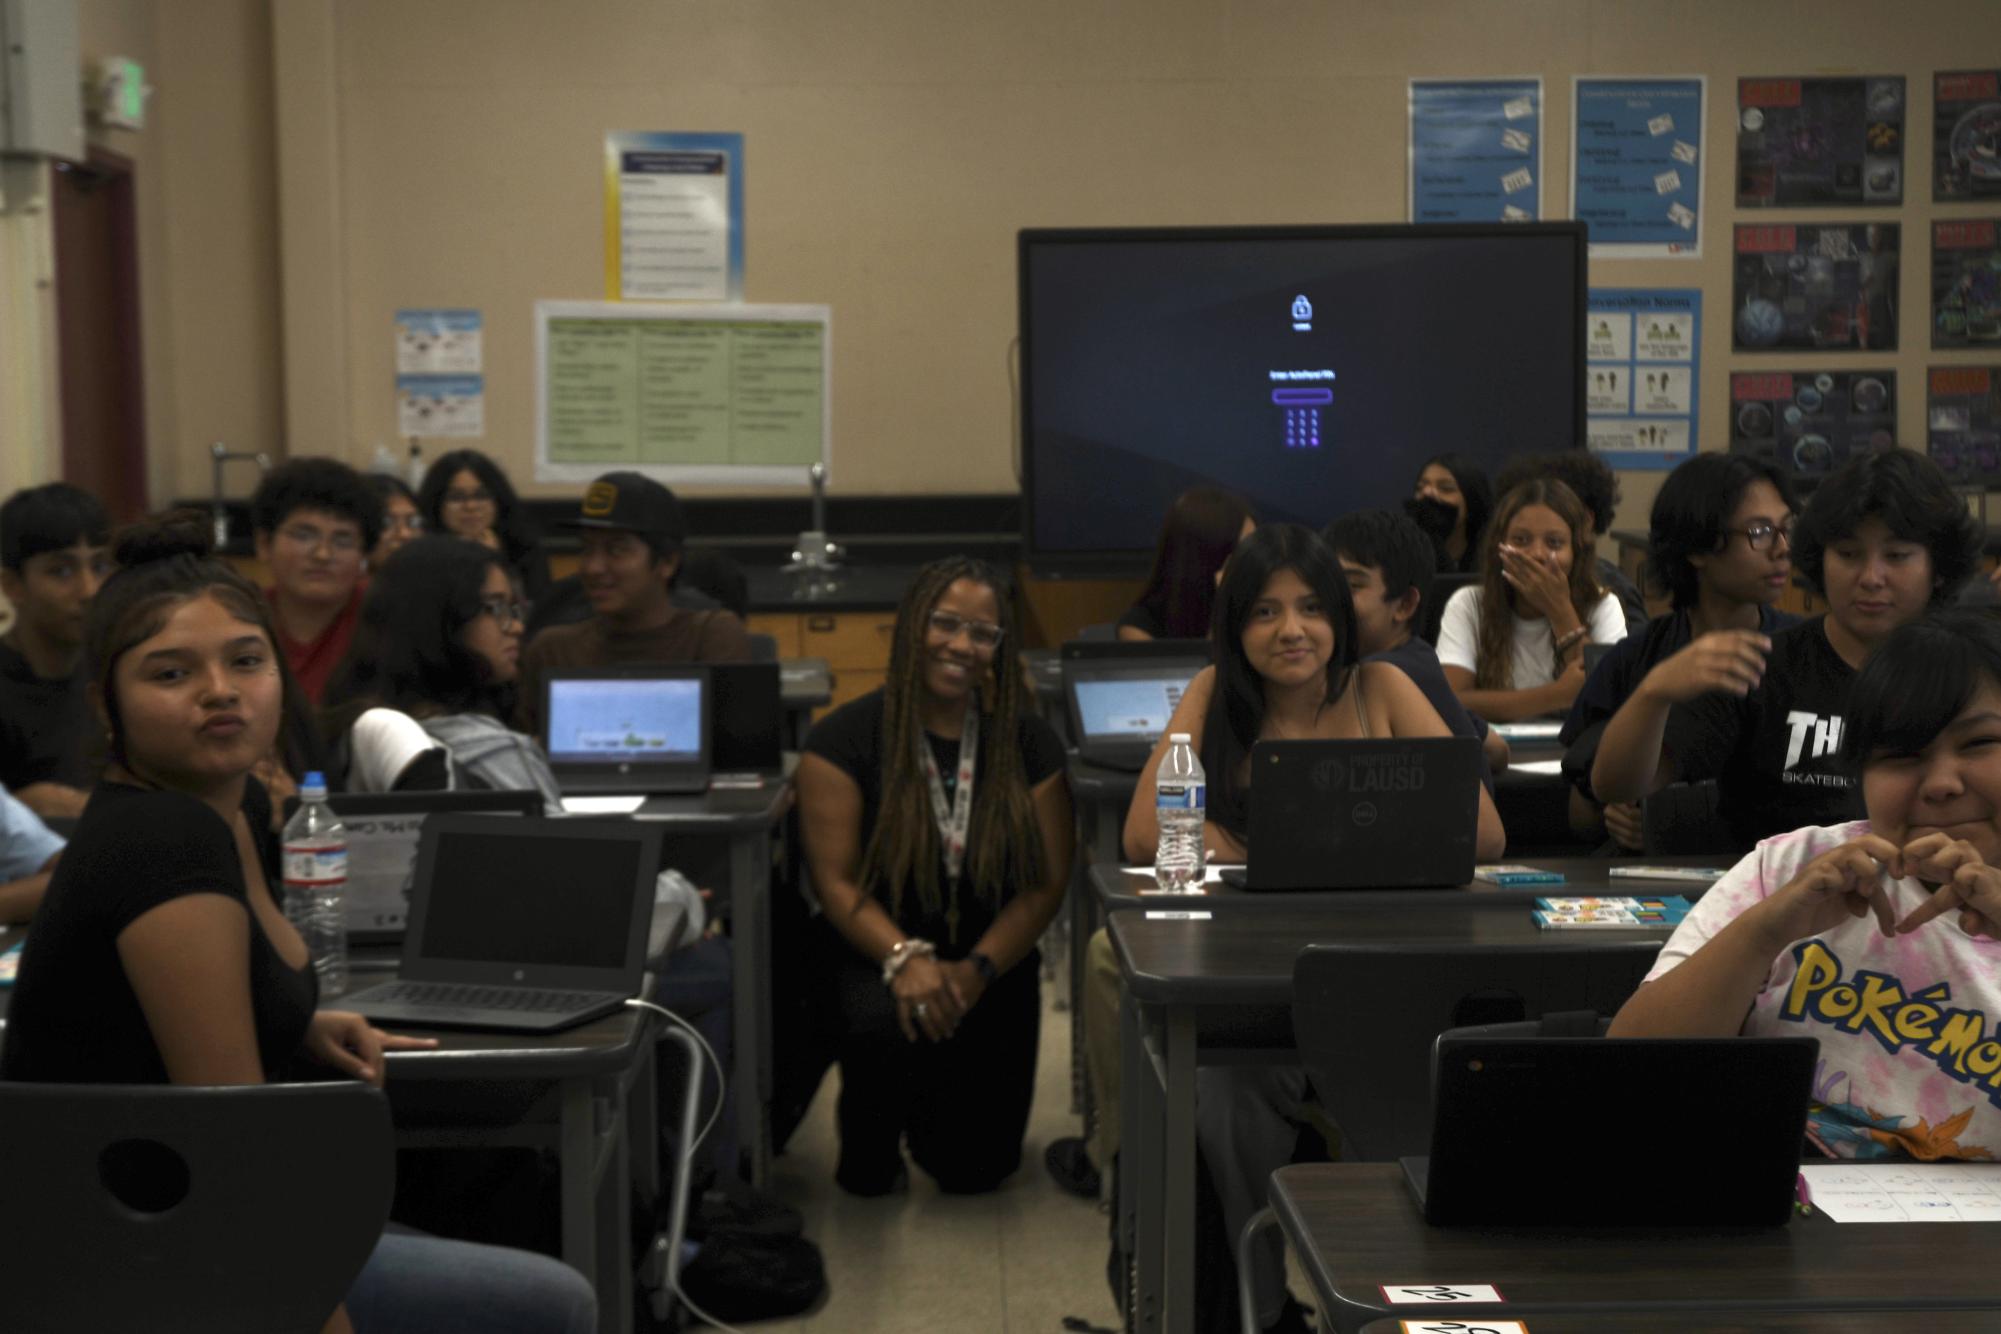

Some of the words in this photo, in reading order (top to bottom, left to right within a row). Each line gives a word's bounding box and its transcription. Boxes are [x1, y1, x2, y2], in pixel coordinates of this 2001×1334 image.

[1784, 710, 1847, 771] TH
[1349, 767, 1425, 792] LAUSD
[1402, 1286, 1472, 1300] 25
